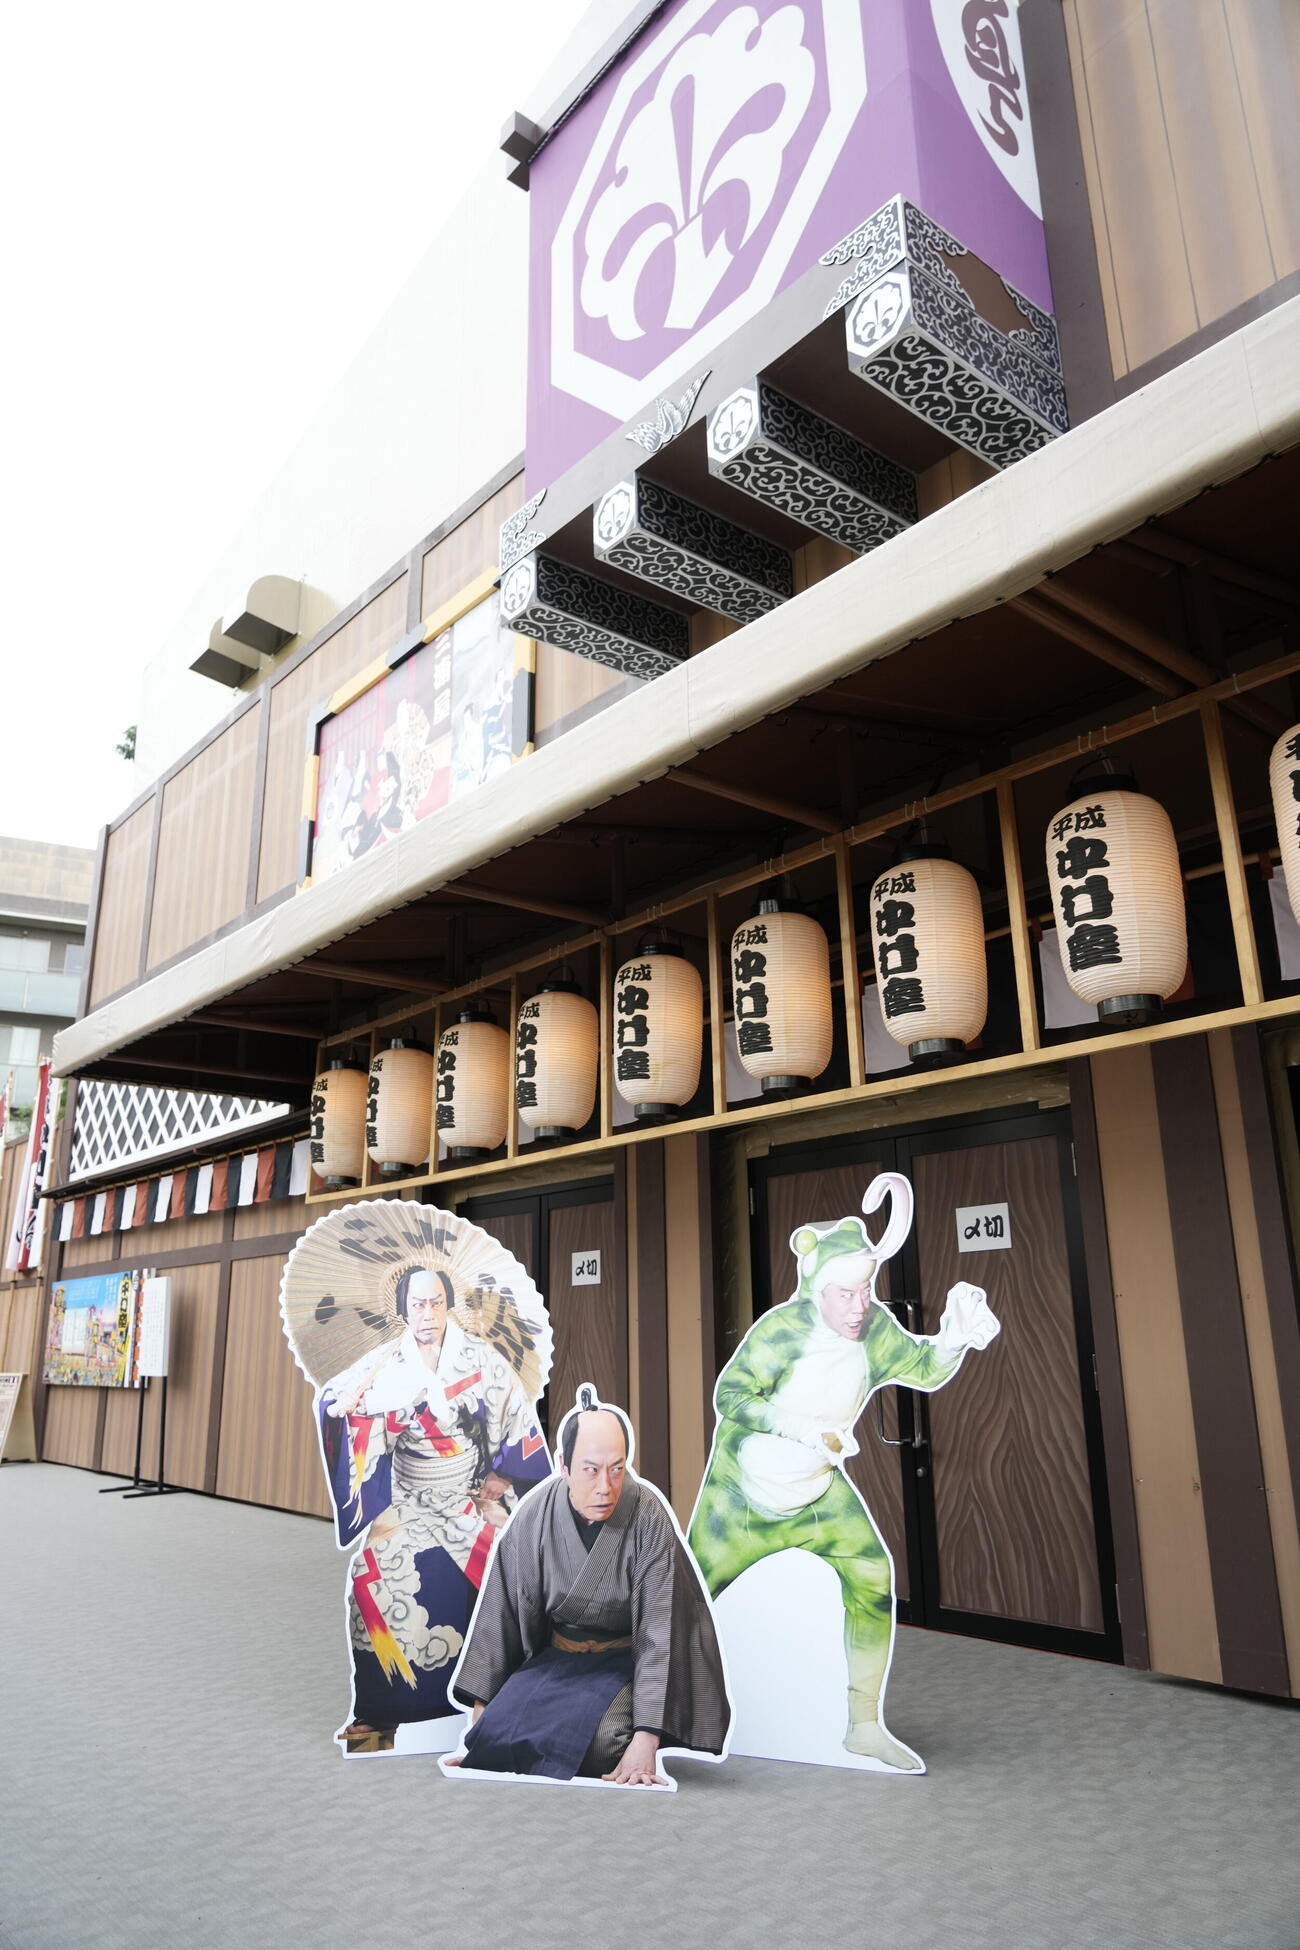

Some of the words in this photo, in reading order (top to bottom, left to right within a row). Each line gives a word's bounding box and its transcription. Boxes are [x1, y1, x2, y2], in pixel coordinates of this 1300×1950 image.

[1051, 804, 1107, 841] 平成
[873, 871, 916, 902] 平成
[732, 924, 768, 951] 平成
[617, 963, 652, 986] 平成
[964, 1215, 1004, 1239] 〆切
[575, 1258, 597, 1276] 〆切
